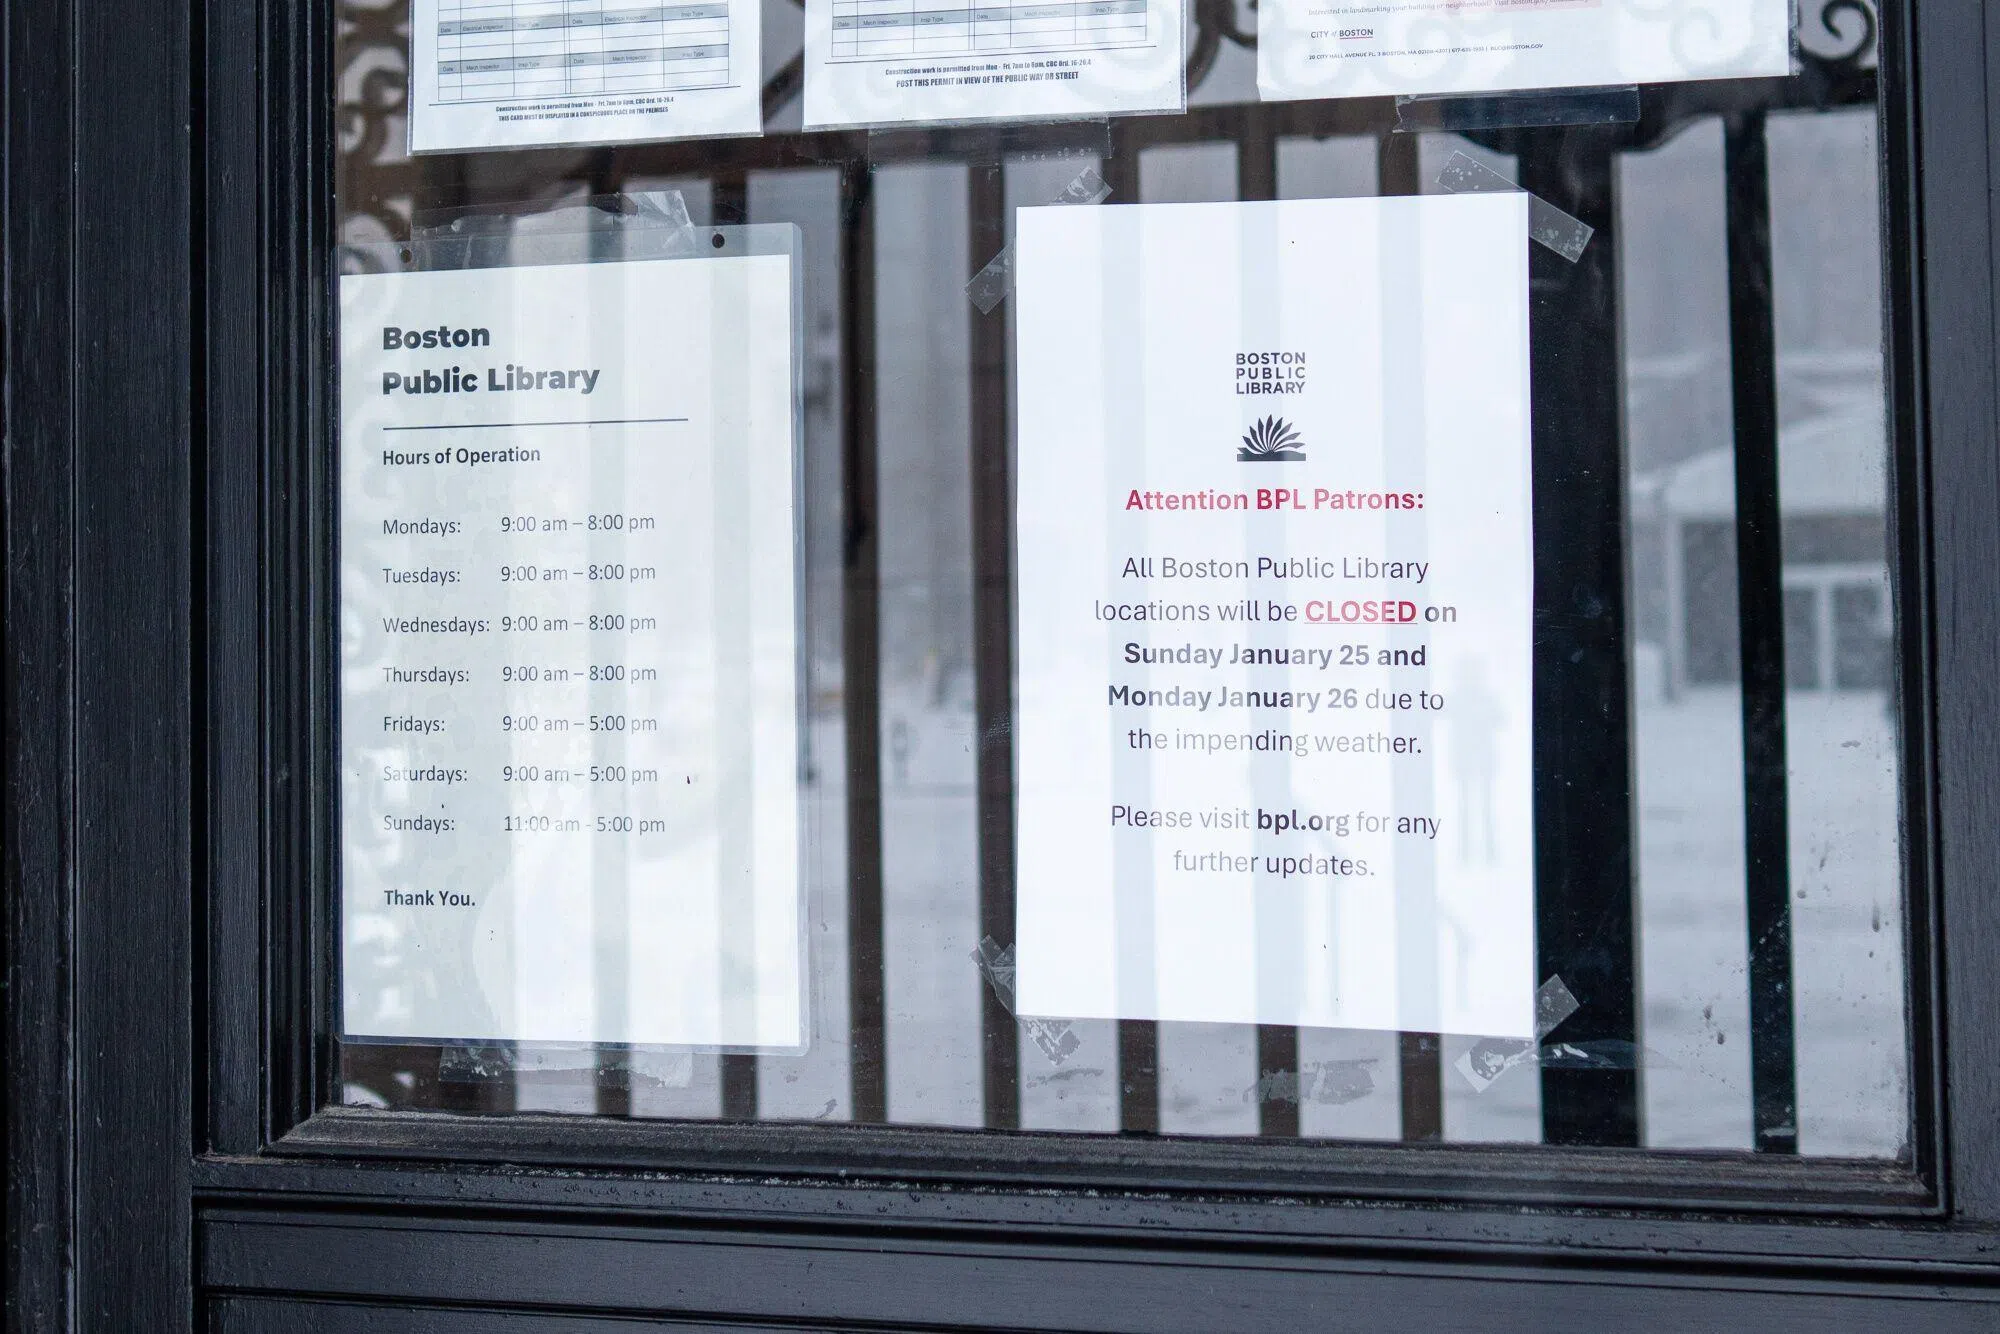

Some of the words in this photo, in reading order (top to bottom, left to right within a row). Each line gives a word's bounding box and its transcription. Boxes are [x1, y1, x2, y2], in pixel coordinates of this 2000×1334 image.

[1310, 30, 1329, 39] CITY
[1339, 28, 1374, 38] BOSTON
[896, 79, 913, 88] POST
[914, 78, 929, 87] THIS
[930, 77, 955, 86] PERMIT
[955, 76, 963, 84] IN
[963, 76, 982, 84] VIEW
[982, 75, 991, 83] OF
[992, 74, 1004, 83] THE
[1004, 73, 1028, 82] PUBLIC
[1029, 72, 1044, 81] WAY
[1045, 72, 1054, 80] OR
[1055, 71, 1079, 80] STREET
[942, 65, 971, 73] permitted
[524, 113, 538, 121] MUST
[382, 326, 490, 351] Boston
[1236, 352, 1305, 366] BOSTON
[383, 366, 478, 395] Public
[488, 364, 600, 395] Library
[1236, 366, 1305, 380] PUBLIC
[1236, 381, 1305, 395] LIBRARY
[383, 450, 430, 466] Hours
[435, 448, 452, 464] of
[456, 446, 540, 467] Operation
[1126, 488, 1248, 511] Attention
[1256, 489, 1306, 510] BPL
[1314, 488, 1424, 511] Patrons:
[384, 518, 460, 537] Mondays:
[500, 515, 537, 533] 9:00
[541, 519, 568, 532] am
[586, 513, 624, 532] 8:00
[628, 516, 654, 532] pm
[382, 567, 460, 586] Tuesdays:
[501, 565, 537, 583] 9:00
[542, 569, 568, 582] am
[588, 564, 624, 581] 8:00
[630, 568, 655, 583] pm
[1122, 557, 1154, 578] All
[1161, 557, 1248, 580] Boston
[1258, 557, 1334, 578] Public
[1344, 557, 1429, 584] Library
[1096, 600, 1210, 623] locations
[1217, 600, 1260, 622] will
[1266, 600, 1297, 623] be
[1304, 600, 1418, 625] CLOSED
[1423, 606, 1456, 624] on
[383, 616, 491, 636] Wednesdays:
[501, 616, 539, 632] 9:00
[542, 619, 568, 632] am
[589, 614, 624, 632] 8:00
[629, 617, 656, 634] pm
[1123, 642, 1223, 669] Sunday
[1230, 644, 1332, 670] January
[1338, 644, 1369, 665] 25
[1377, 645, 1425, 666] and
[383, 666, 469, 685] Thursdays:
[501, 665, 539, 681] 9:00
[543, 669, 568, 682] am
[588, 664, 625, 681] 8:00
[631, 666, 656, 684] pm
[1109, 684, 1212, 712] Monday
[1218, 686, 1320, 713] January
[1328, 688, 1359, 709] 26
[1366, 688, 1413, 711] due
[1419, 691, 1444, 711] to
[384, 715, 444, 736] Fridays:
[501, 715, 538, 733] 9:00
[544, 719, 568, 732] am
[588, 715, 625, 733] 5:00
[631, 718, 657, 736] pm
[1128, 728, 1167, 749] the
[1177, 728, 1308, 757] impending
[1315, 732, 1423, 755] weather.
[384, 765, 468, 785] Saturdays:
[503, 765, 540, 783] 9:00
[543, 769, 570, 782] am
[589, 765, 626, 783] 5:00
[630, 768, 658, 785] pm
[384, 814, 455, 835] Sundays:
[504, 816, 550, 832] 11:00
[554, 819, 580, 832] am
[597, 816, 633, 832] 5:00
[639, 818, 665, 836] pm
[1112, 805, 1192, 828] Please
[1199, 807, 1251, 829] visit
[1256, 808, 1349, 837] bpl.org
[1356, 811, 1390, 832] for
[1397, 816, 1441, 839] any
[1173, 848, 1259, 873] further
[1264, 853, 1374, 878] updates.
[384, 889, 435, 907] Thank
[439, 890, 475, 908] You.
